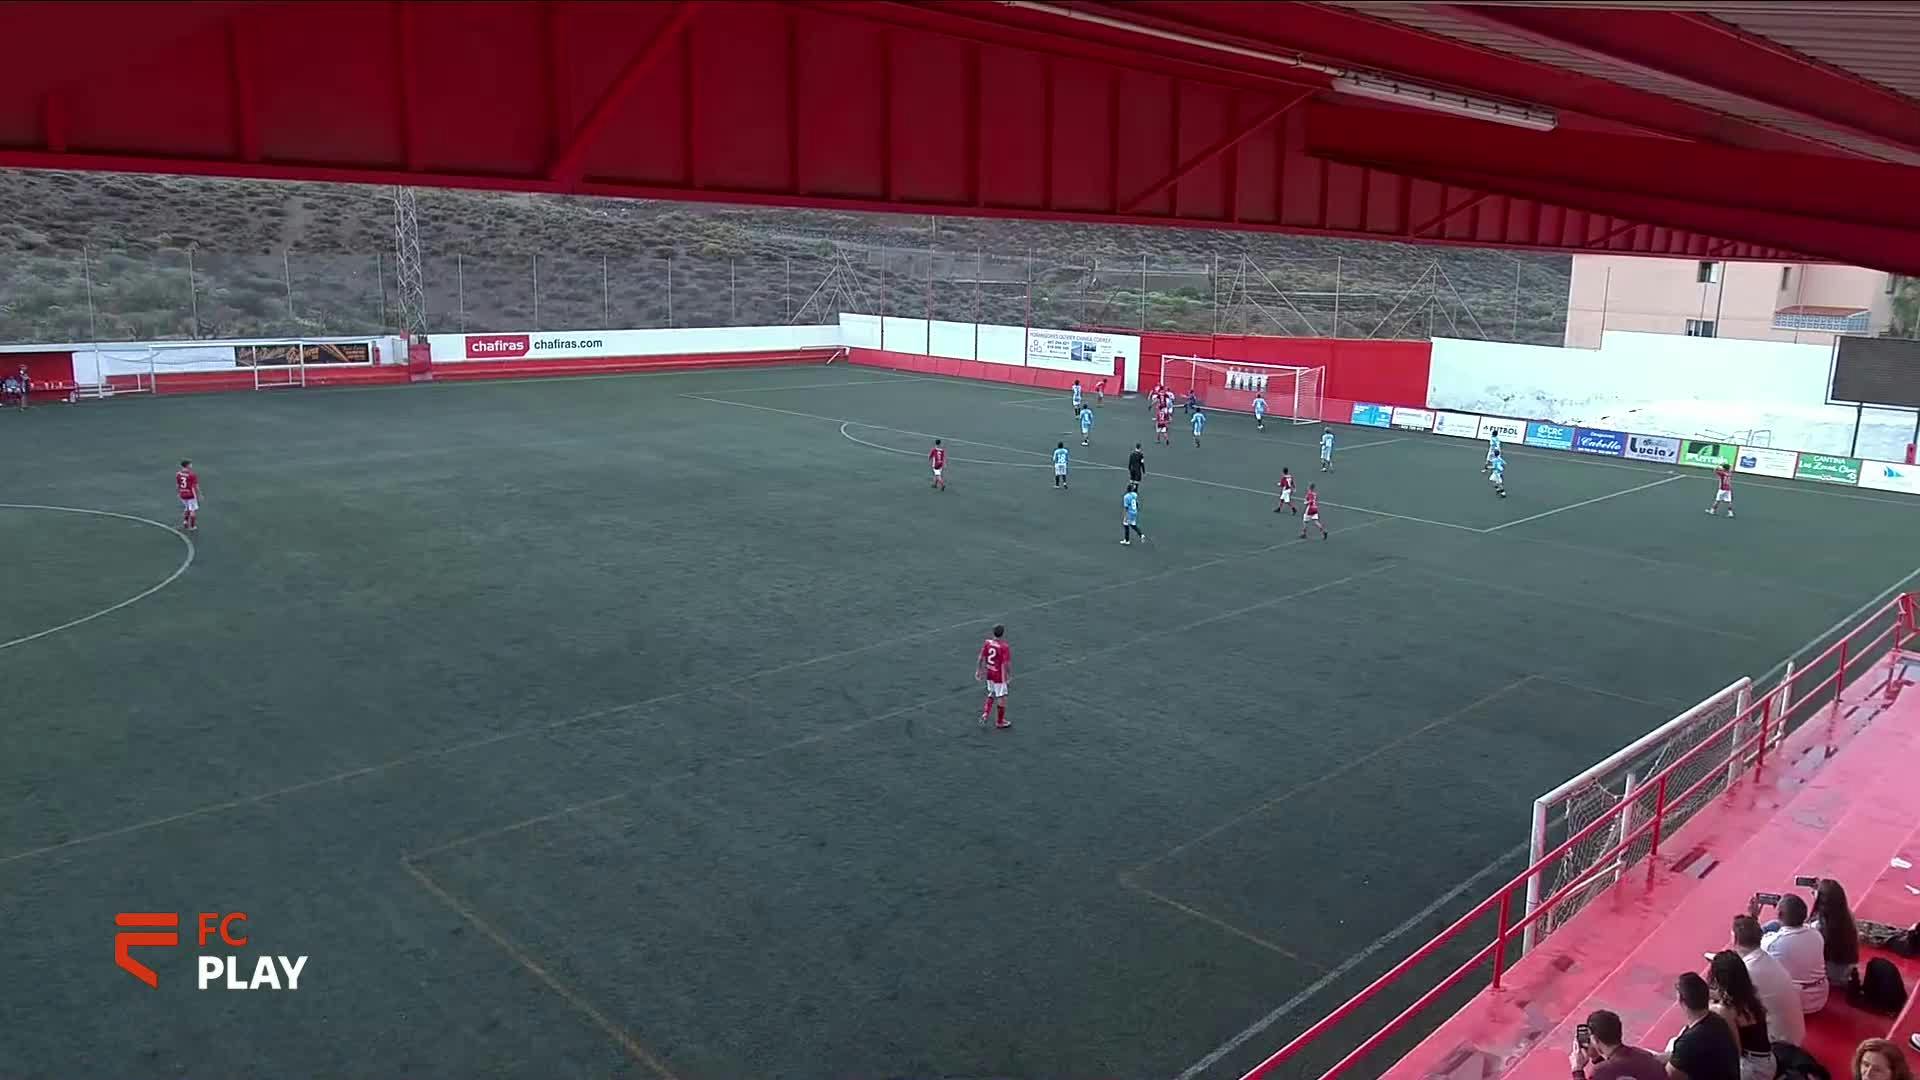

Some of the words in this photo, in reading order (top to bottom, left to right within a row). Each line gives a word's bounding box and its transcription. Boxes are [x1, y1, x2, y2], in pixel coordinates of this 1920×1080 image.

[472, 340, 524, 352] chafiras
[534, 339, 603, 350] chafiras.com
[1580, 437, 1622, 450] Cabello
[1813, 455, 1846, 465] CANTINA
[180, 476, 187, 489] 3
[1131, 499, 1137, 510] 9
[987, 647, 997, 665] 2
